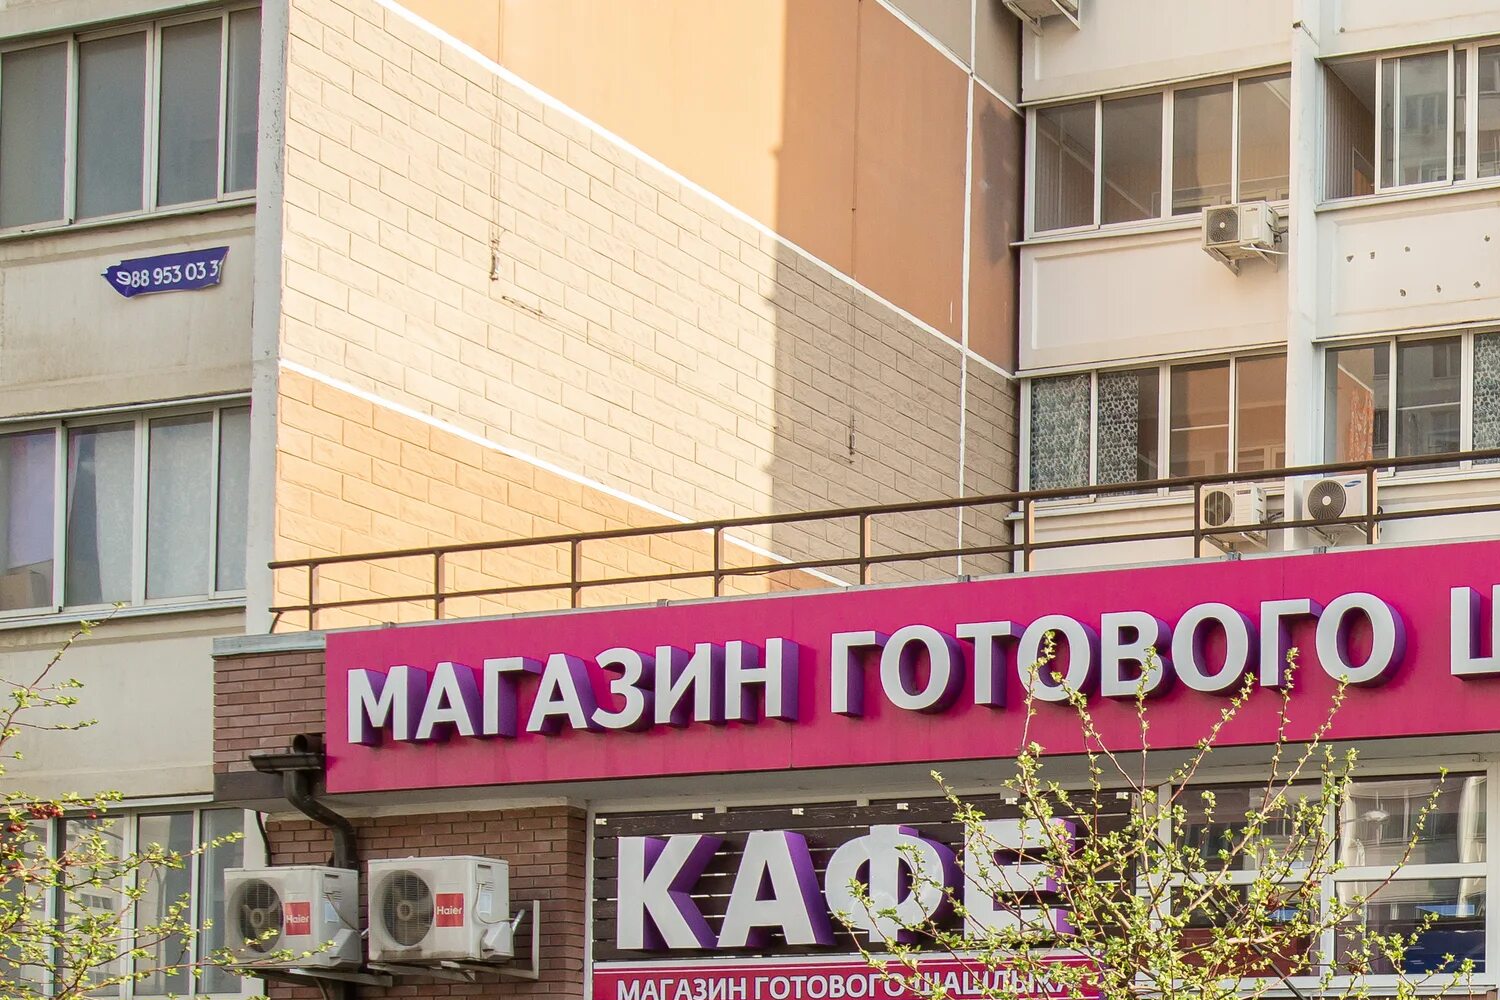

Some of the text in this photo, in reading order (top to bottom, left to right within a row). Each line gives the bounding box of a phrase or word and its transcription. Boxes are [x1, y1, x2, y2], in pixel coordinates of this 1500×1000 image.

[153, 265, 181, 285] 953
[185, 262, 207, 281] 03
[347, 636, 798, 746] МАГАЗИН
[830, 590, 1405, 718] ГОТОВОГО
[617, 816, 1074, 949] КАФЕ
[286, 913, 311, 925] Haier
[436, 905, 463, 916] Haier
[754, 971, 906, 1000] ГОТОВОГО
